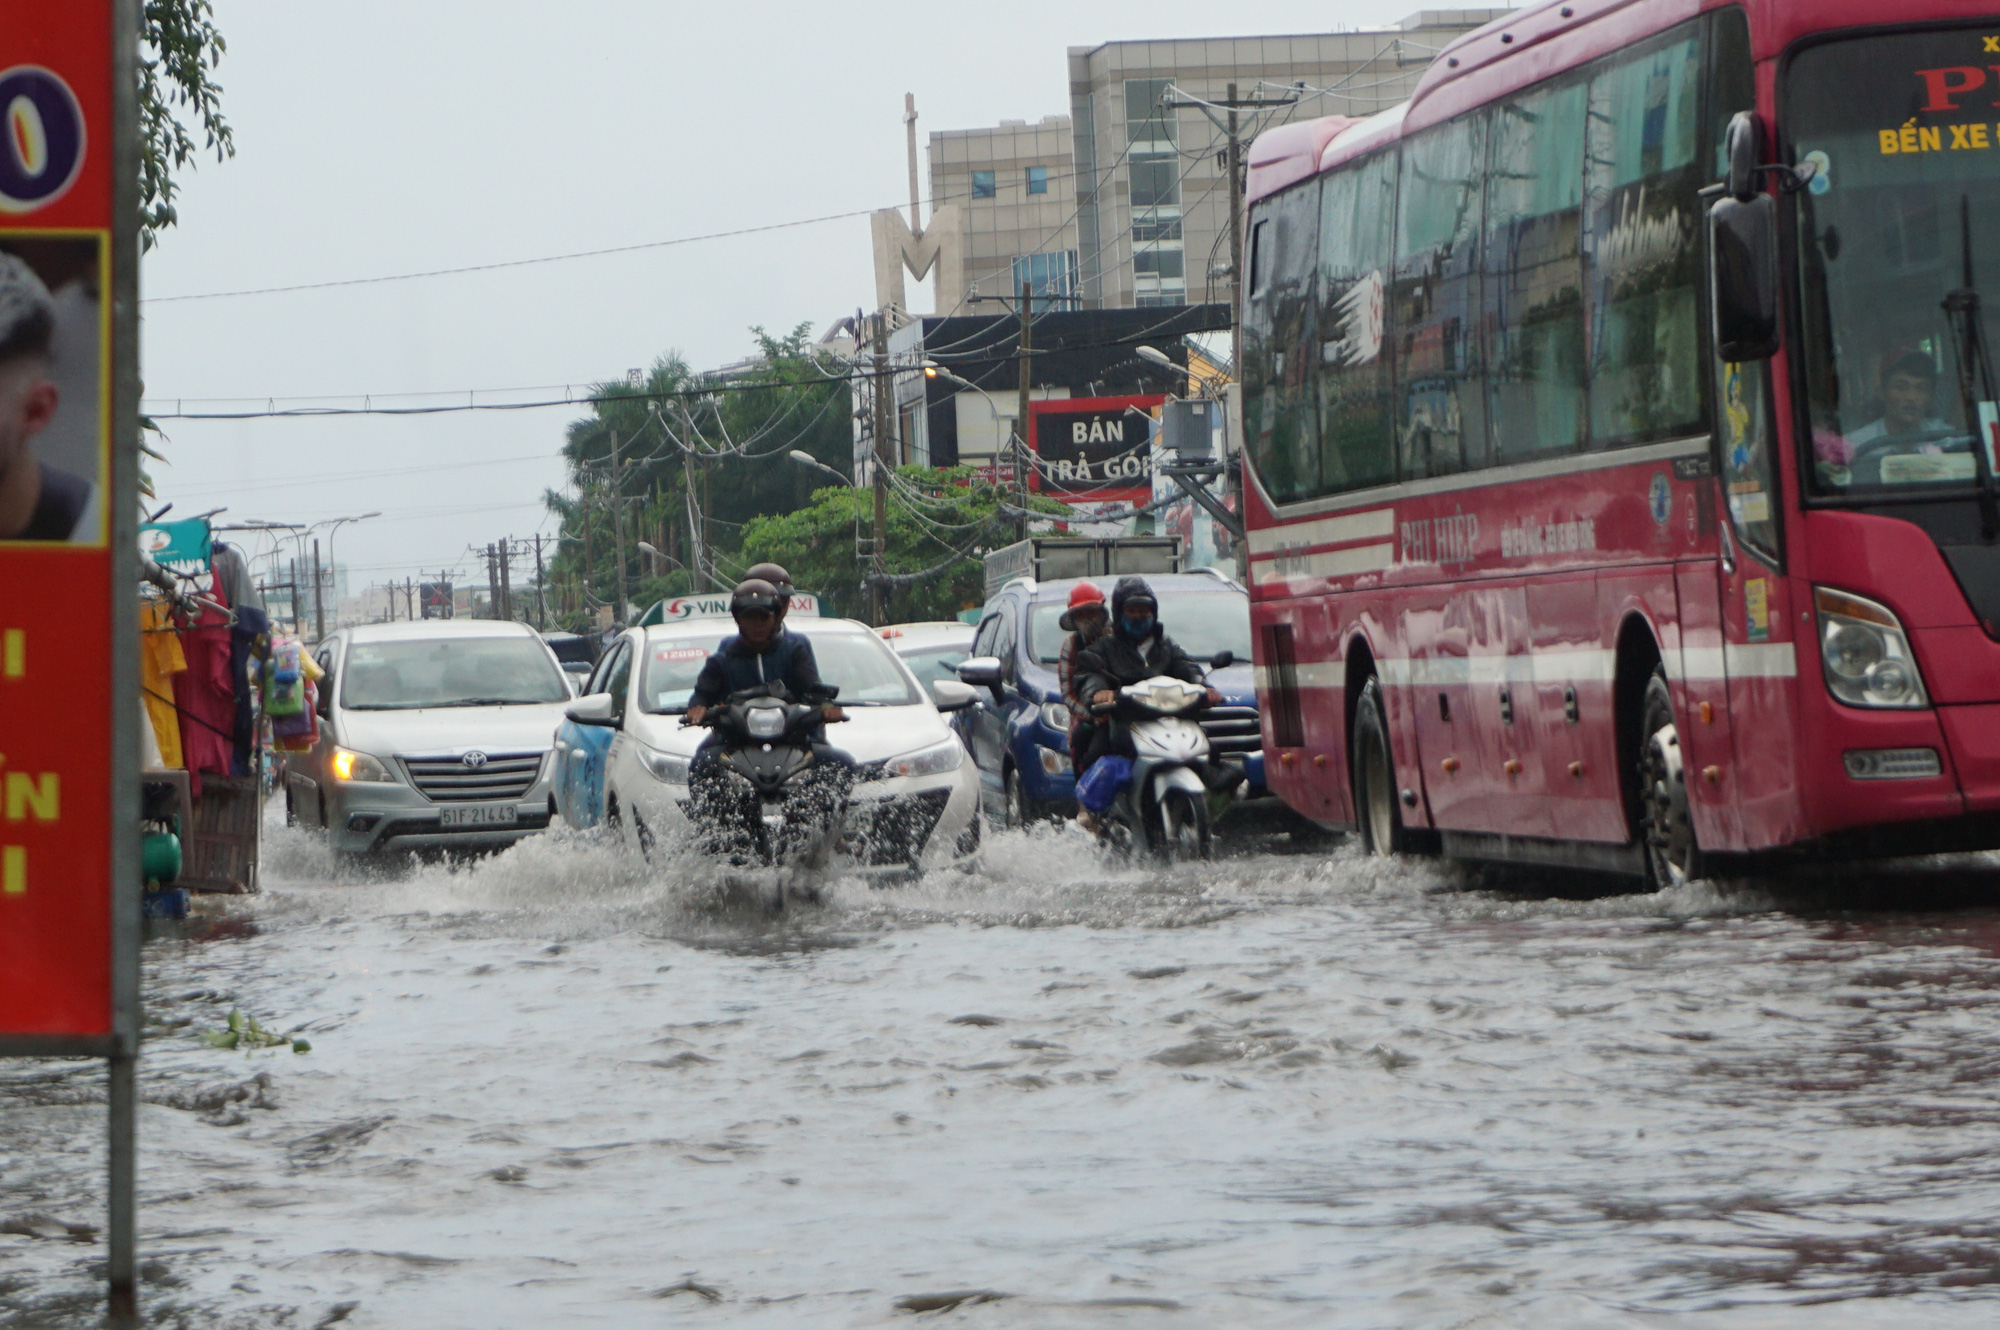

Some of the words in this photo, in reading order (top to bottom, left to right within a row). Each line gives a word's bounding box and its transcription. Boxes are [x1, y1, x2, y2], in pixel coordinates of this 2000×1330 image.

[1914, 65, 2000, 111] P
[1879, 117, 1941, 154] BẾN
[1949, 123, 1990, 150] XE
[1072, 415, 1124, 444] BÁN
[1046, 451, 1092, 481] TRẢ
[1399, 520, 1431, 566] PHI
[1434, 503, 1477, 572] HIỆP
[443, 806, 515, 823] 51F-214.43
